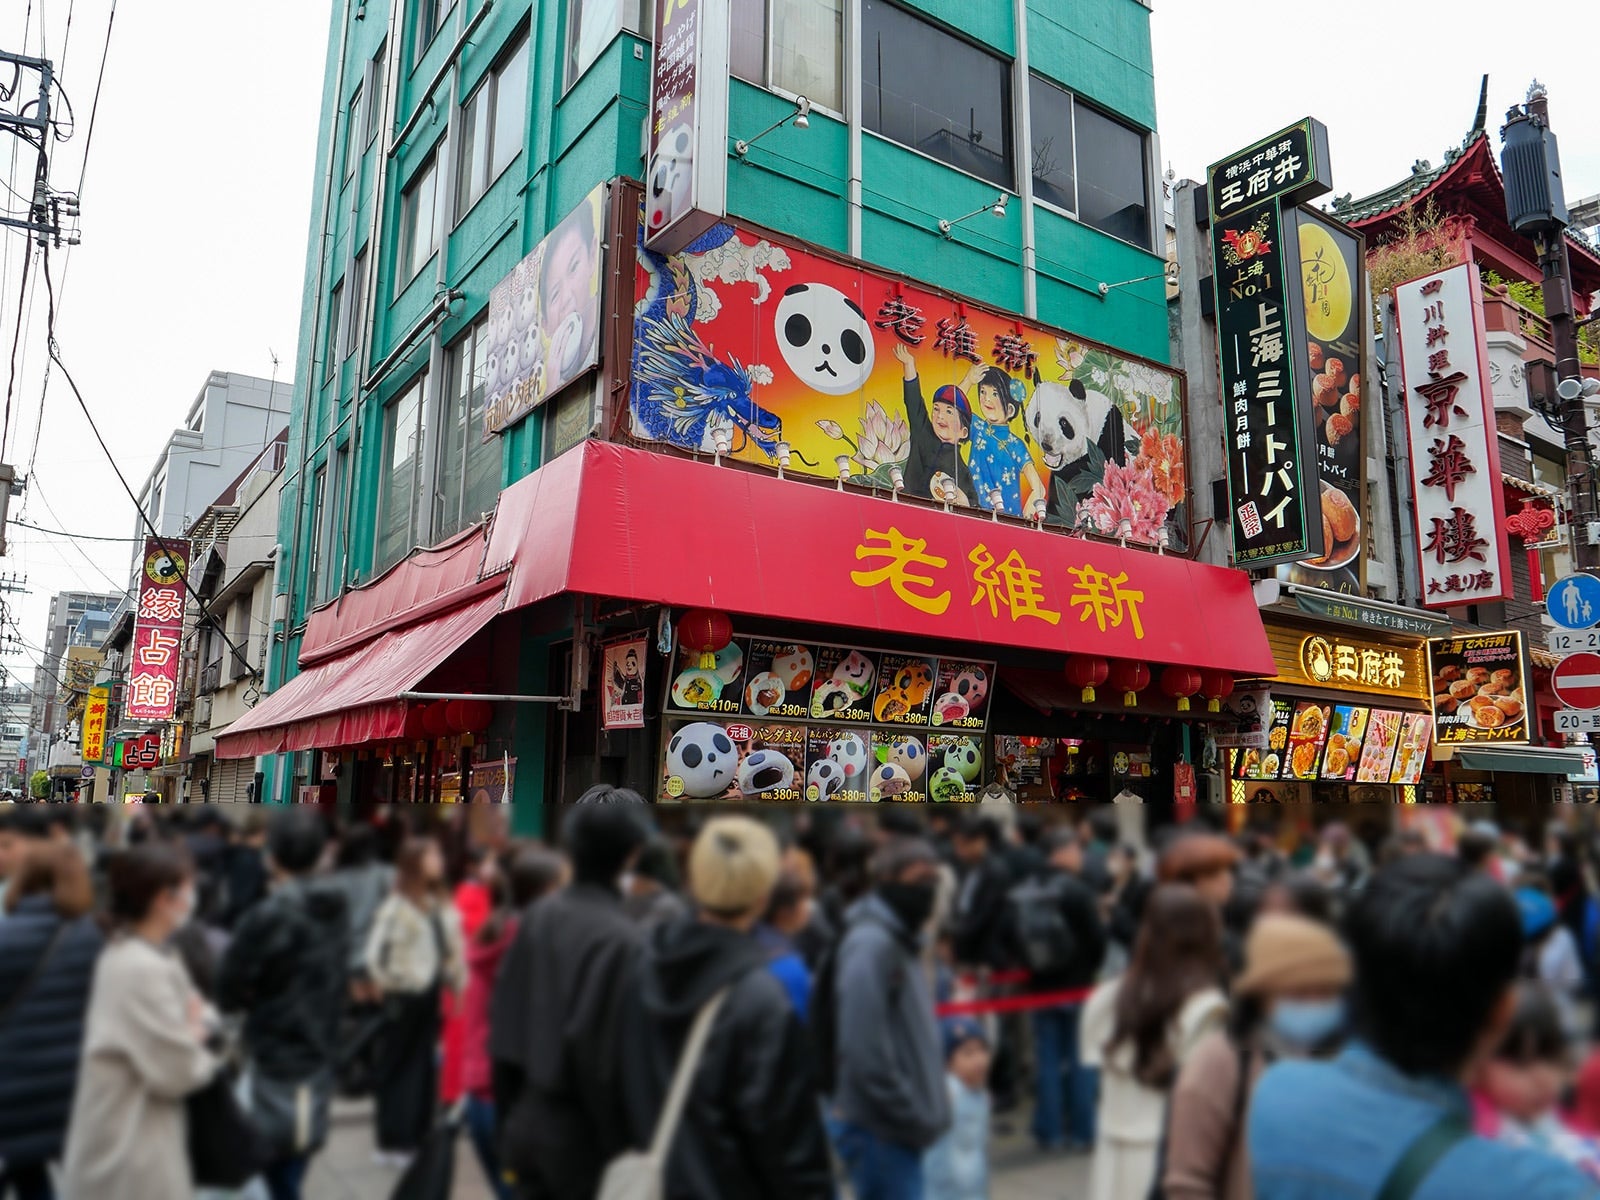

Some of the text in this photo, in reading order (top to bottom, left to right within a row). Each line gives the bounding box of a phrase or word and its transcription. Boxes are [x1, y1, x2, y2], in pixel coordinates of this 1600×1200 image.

[658, 9, 696, 60] おみやげ
[1225, 139, 1292, 180] 横浜中華街
[1220, 154, 1302, 210] 王府井
[1232, 260, 1265, 286] 上海
[1229, 275, 1273, 303] No.1
[1420, 279, 1451, 372] 四川料理
[873, 299, 1038, 379] 老維新
[1233, 380, 1252, 450] 鮮肉月餅
[1248, 303, 1295, 529] 上海ミートパイ
[850, 526, 1144, 640] 老維新
[1427, 568, 1494, 595] 大通り店
[1342, 606, 1358, 621] No.1
[131, 587, 183, 708] 縁占館
[1335, 644, 1405, 689] 王府井
[697, 699, 739, 712] 税込410円
[769, 703, 808, 716] 税込380円
[834, 708, 871, 721] 税込380円
[894, 711, 928, 725] 税込380円
[952, 715, 984, 728] 税込380円
[1440, 726, 1523, 741] 上海ミートパイ
[729, 727, 803, 743] 元祖 パンダまん
[126, 746, 139, 766] 占
[139, 740, 160, 764] 占
[761, 788, 800, 801] 税込380円
